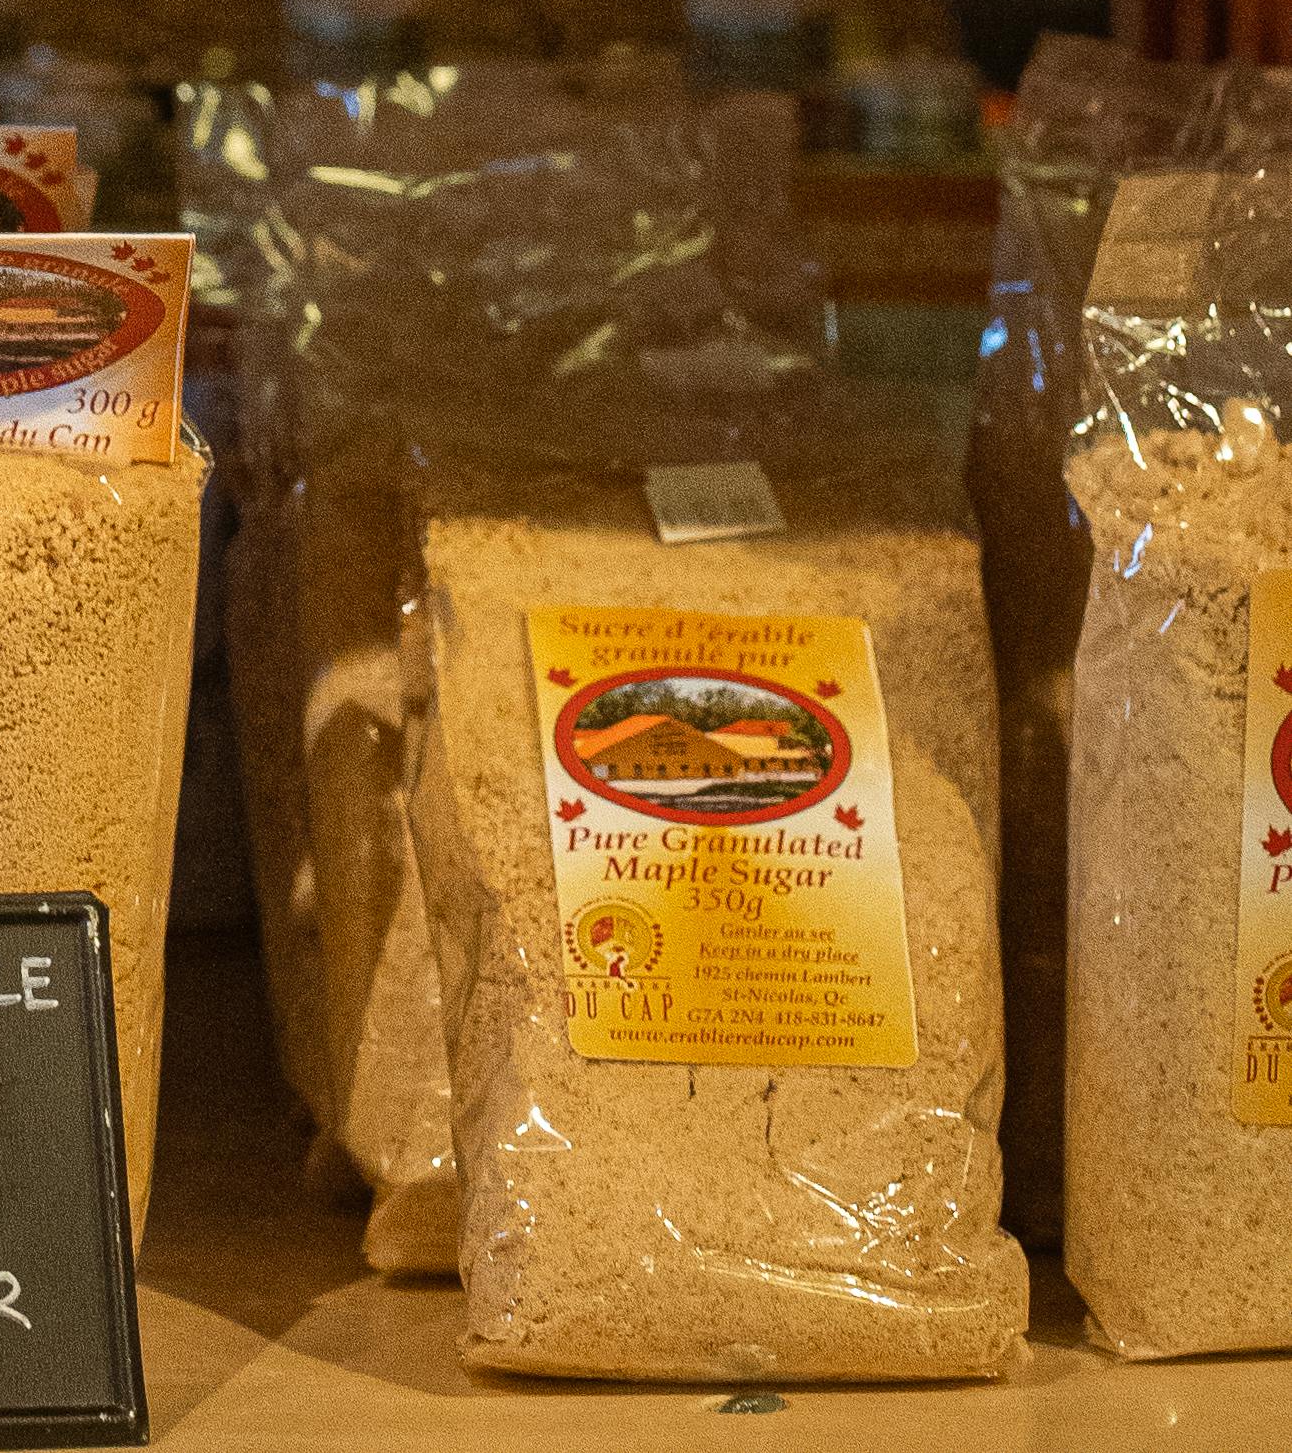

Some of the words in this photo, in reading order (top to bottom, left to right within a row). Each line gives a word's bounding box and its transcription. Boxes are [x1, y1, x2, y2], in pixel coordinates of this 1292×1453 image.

[67, 387, 131, 417] 300
[139, 399, 161, 429] g
[567, 826, 649, 853] Pure
[661, 827, 864, 861] Granulated
[604, 856, 718, 891] Maple
[729, 857, 833, 894] Sugar
[683, 887, 763, 921] 350g
